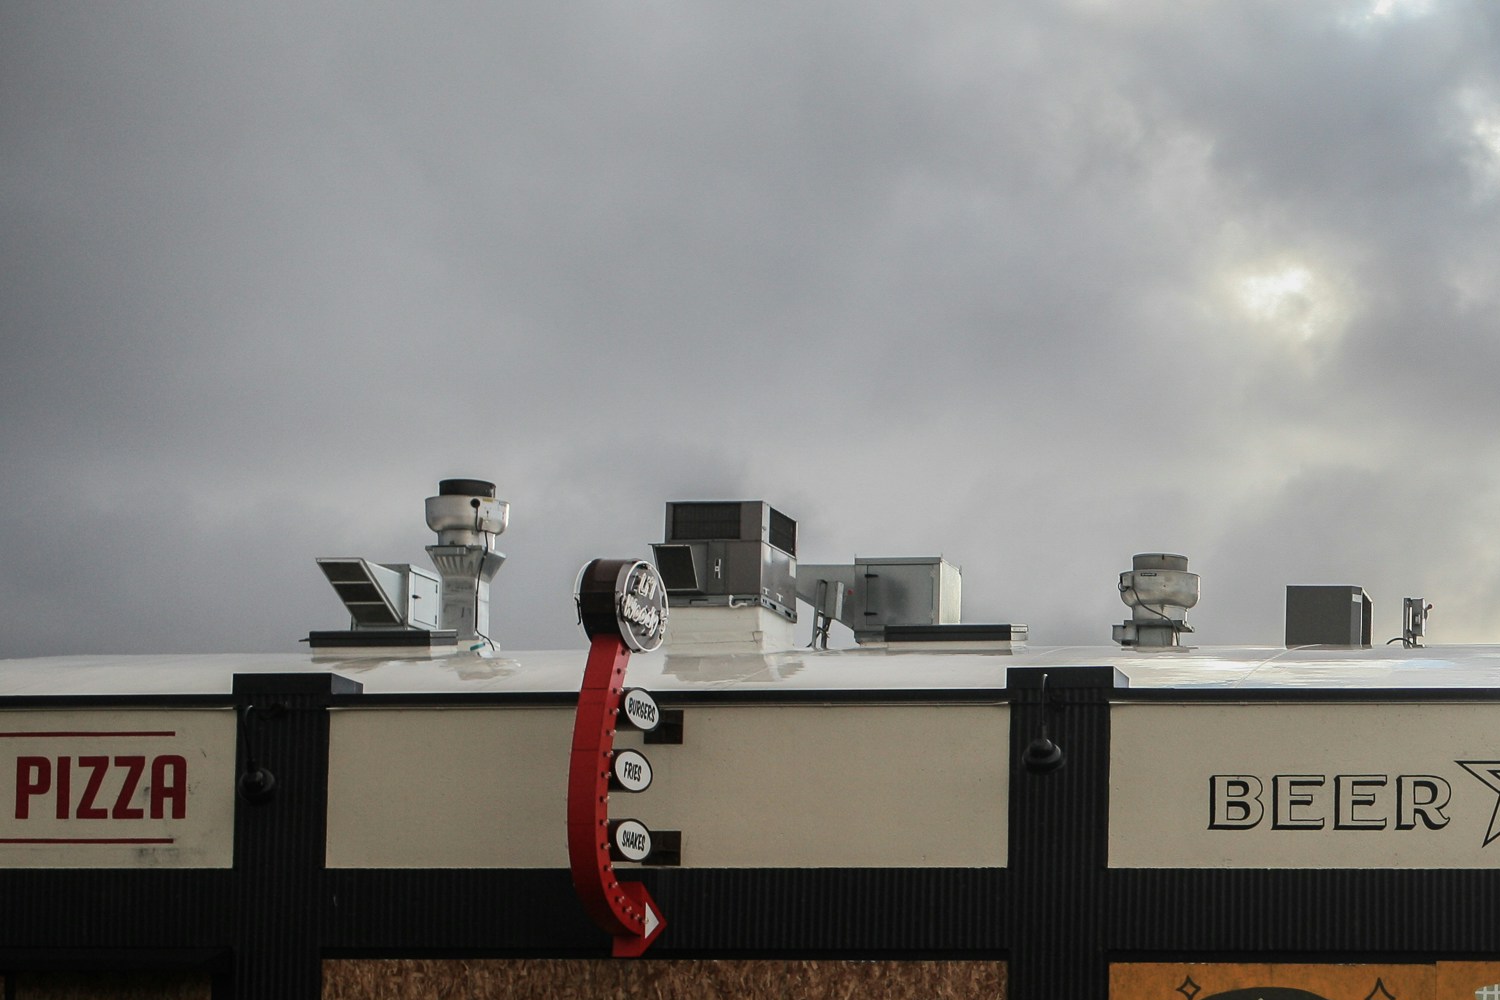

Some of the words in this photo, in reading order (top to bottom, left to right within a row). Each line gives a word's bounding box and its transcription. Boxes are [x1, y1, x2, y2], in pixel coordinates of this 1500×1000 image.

[628, 697, 656, 723] BURGERS
[623, 761, 642, 782] FRIES
[14, 754, 188, 820] PIZZA
[1207, 774, 1453, 831] BEER
[622, 830, 646, 852] SHAKES
